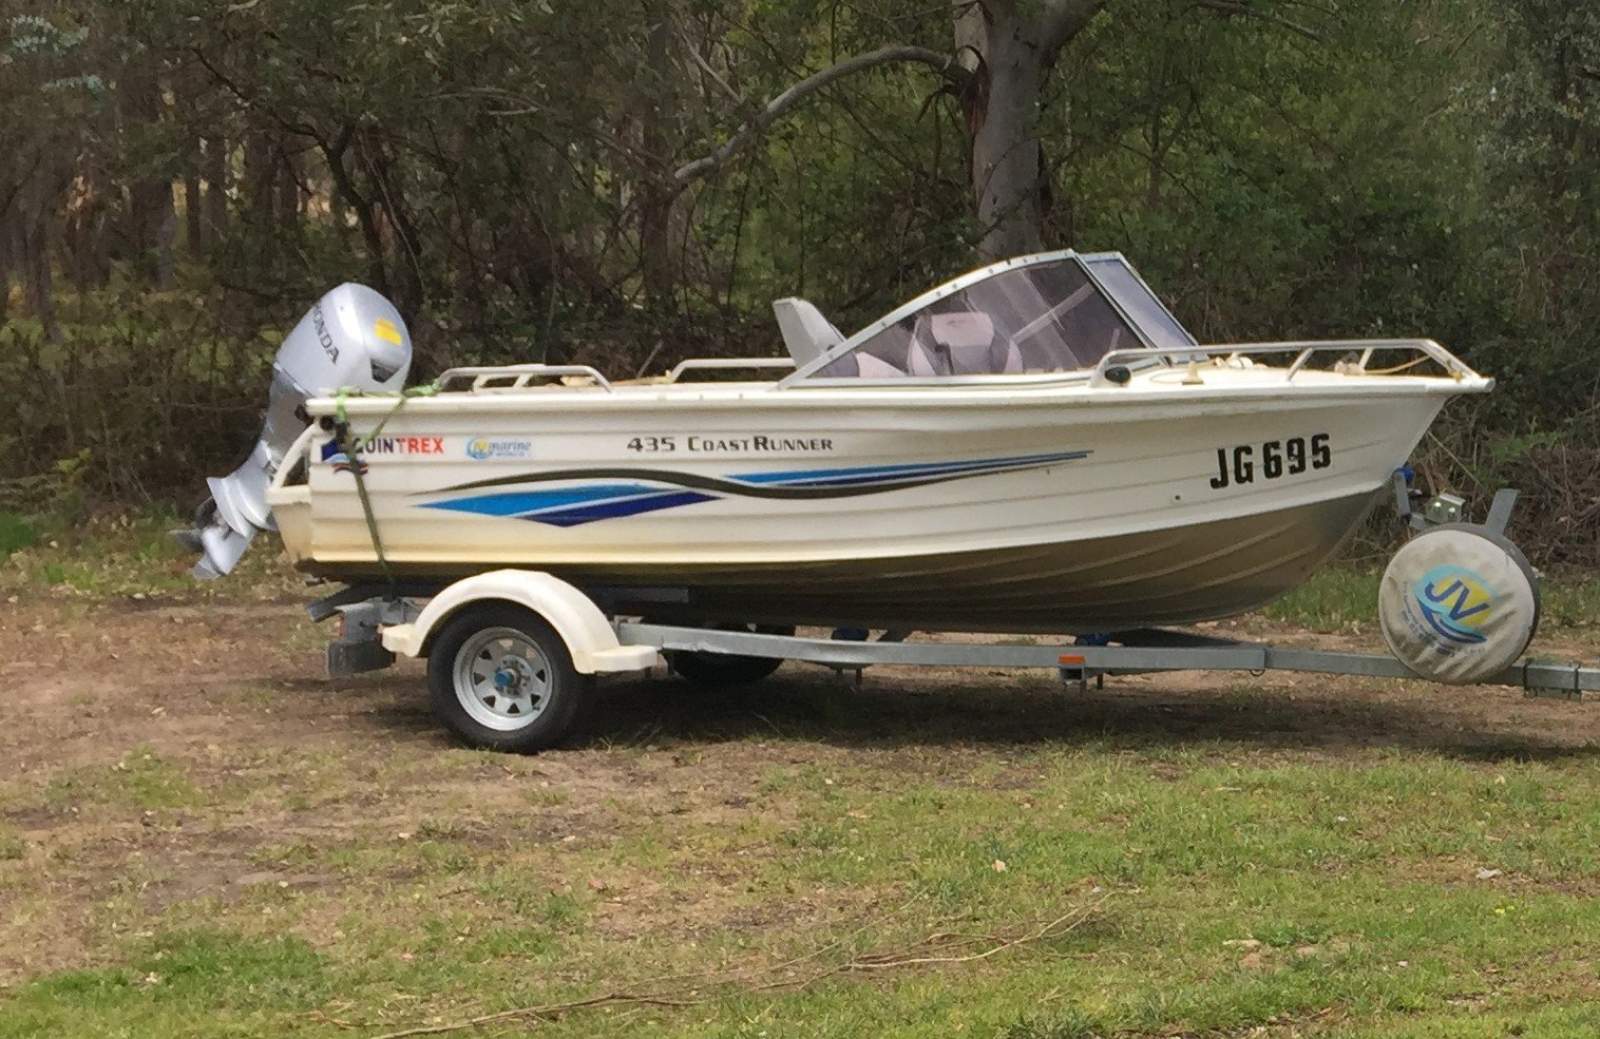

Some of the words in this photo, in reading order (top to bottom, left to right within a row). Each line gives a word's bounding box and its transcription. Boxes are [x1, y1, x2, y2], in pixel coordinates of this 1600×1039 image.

[627, 436, 676, 452] 435
[1209, 445, 1254, 489] JG
[1262, 433, 1332, 479] 695
[1425, 579, 1490, 620] JV
